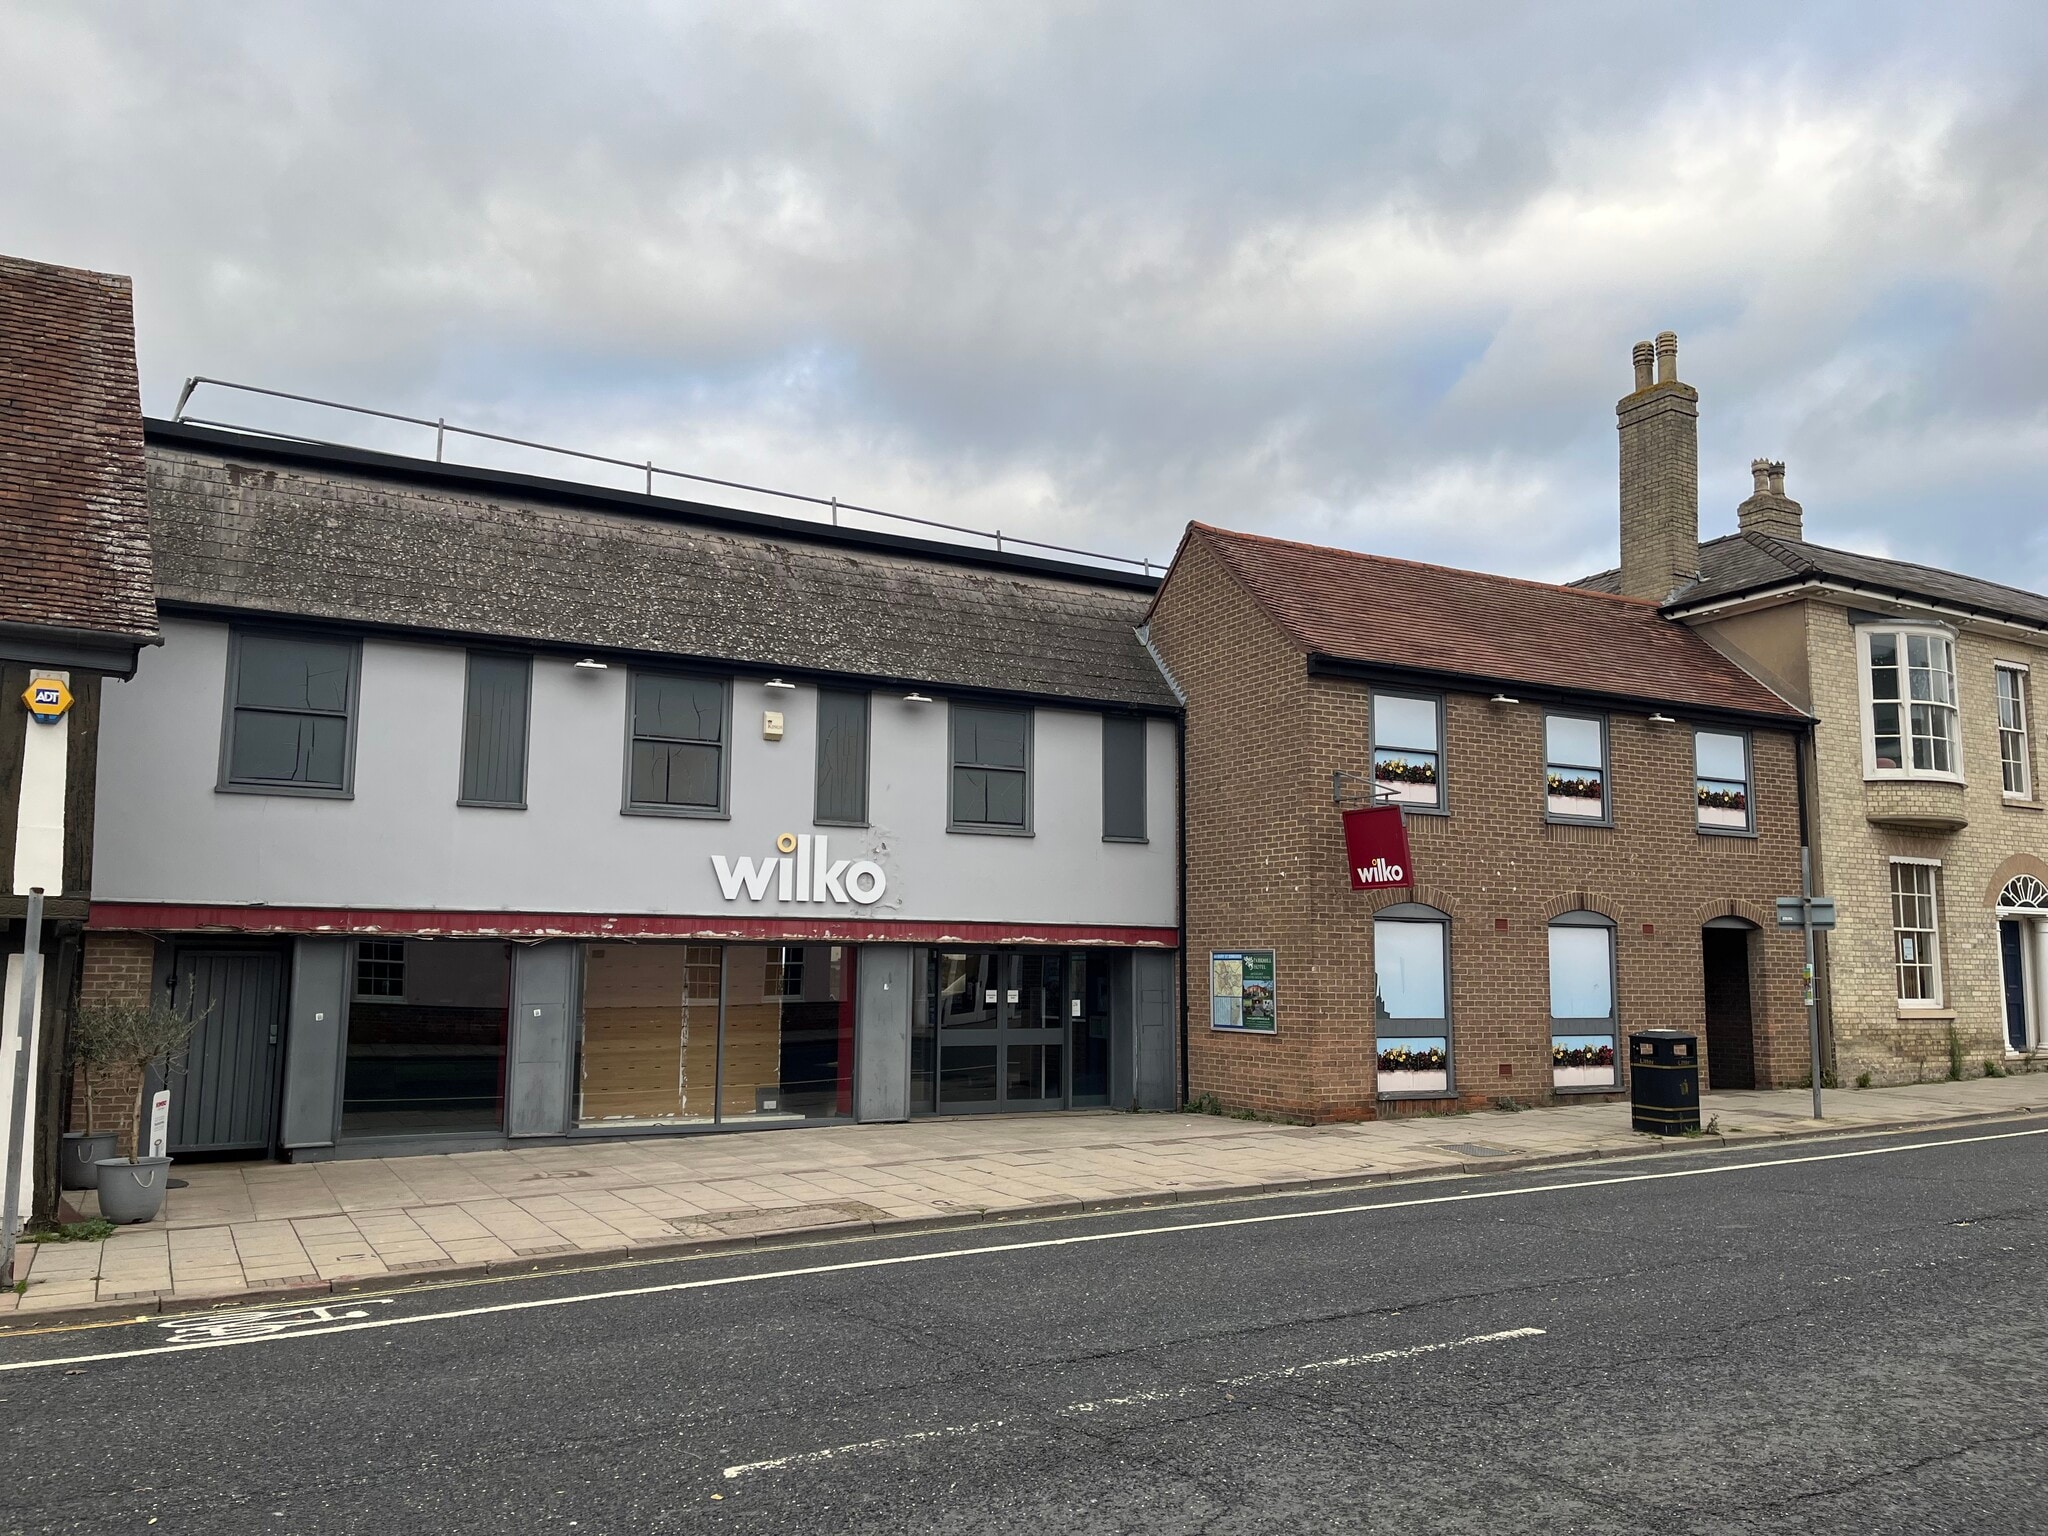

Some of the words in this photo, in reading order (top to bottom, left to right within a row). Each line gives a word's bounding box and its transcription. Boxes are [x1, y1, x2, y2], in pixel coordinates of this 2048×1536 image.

[35, 691, 59, 703] ADT
[711, 833, 886, 904] wilko
[1357, 858, 1403, 883] wilko
